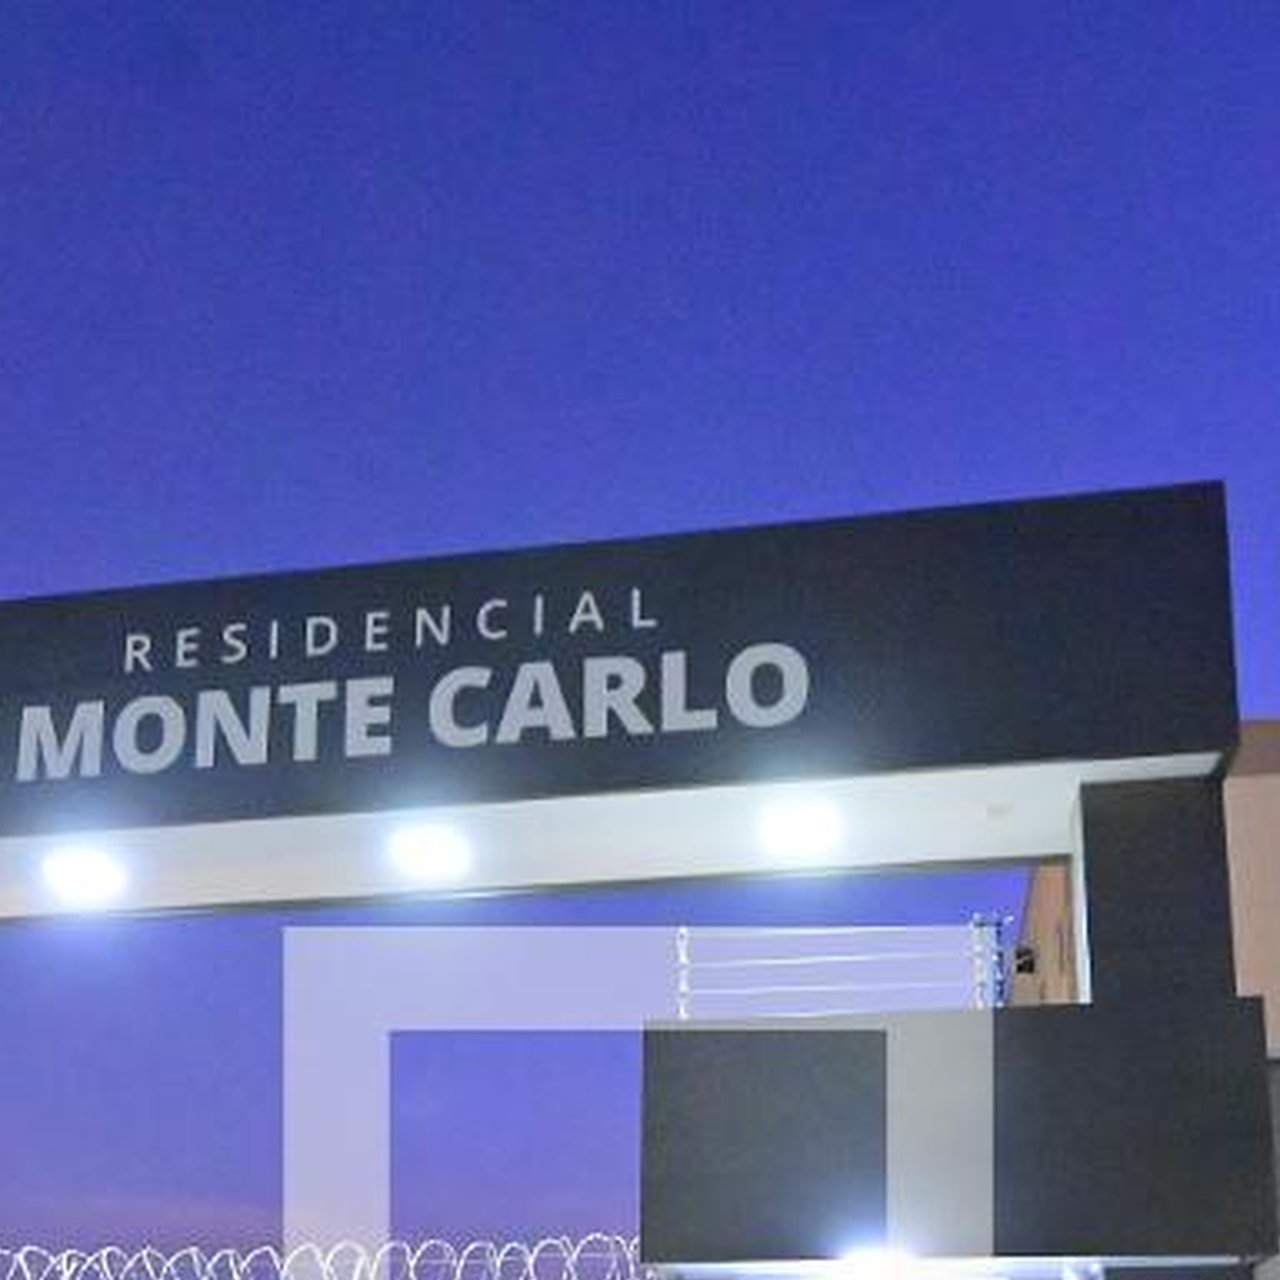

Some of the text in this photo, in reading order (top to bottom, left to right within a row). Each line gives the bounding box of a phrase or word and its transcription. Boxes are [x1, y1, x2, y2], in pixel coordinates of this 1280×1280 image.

[124, 588, 658, 673] RESIDENCIAL
[14, 642, 811, 782] MONTE CARLO
